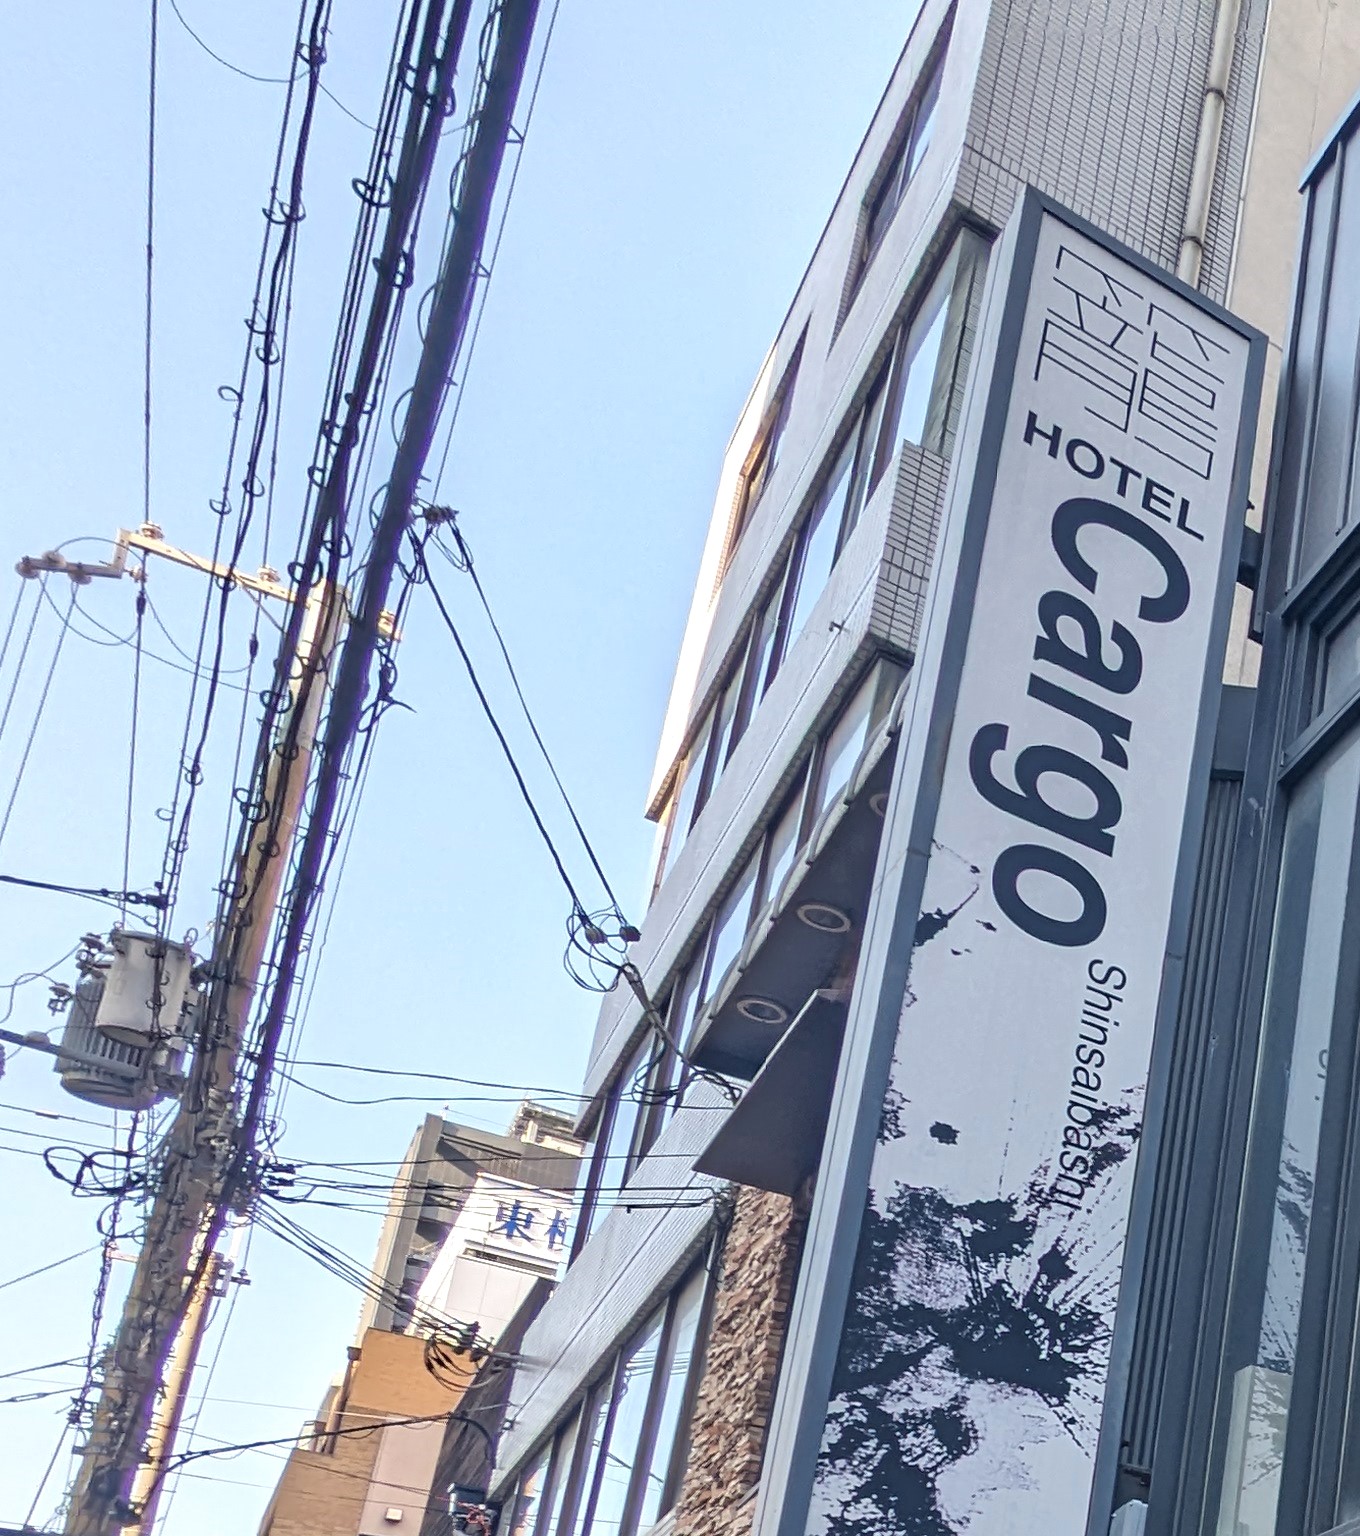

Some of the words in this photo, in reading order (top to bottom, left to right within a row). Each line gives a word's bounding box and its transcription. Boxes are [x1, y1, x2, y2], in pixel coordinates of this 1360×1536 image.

[1023, 411, 1205, 541] HOTEL
[969, 496, 1191, 948] Cargo
[1049, 959, 1127, 1212] Shinsaibashi
